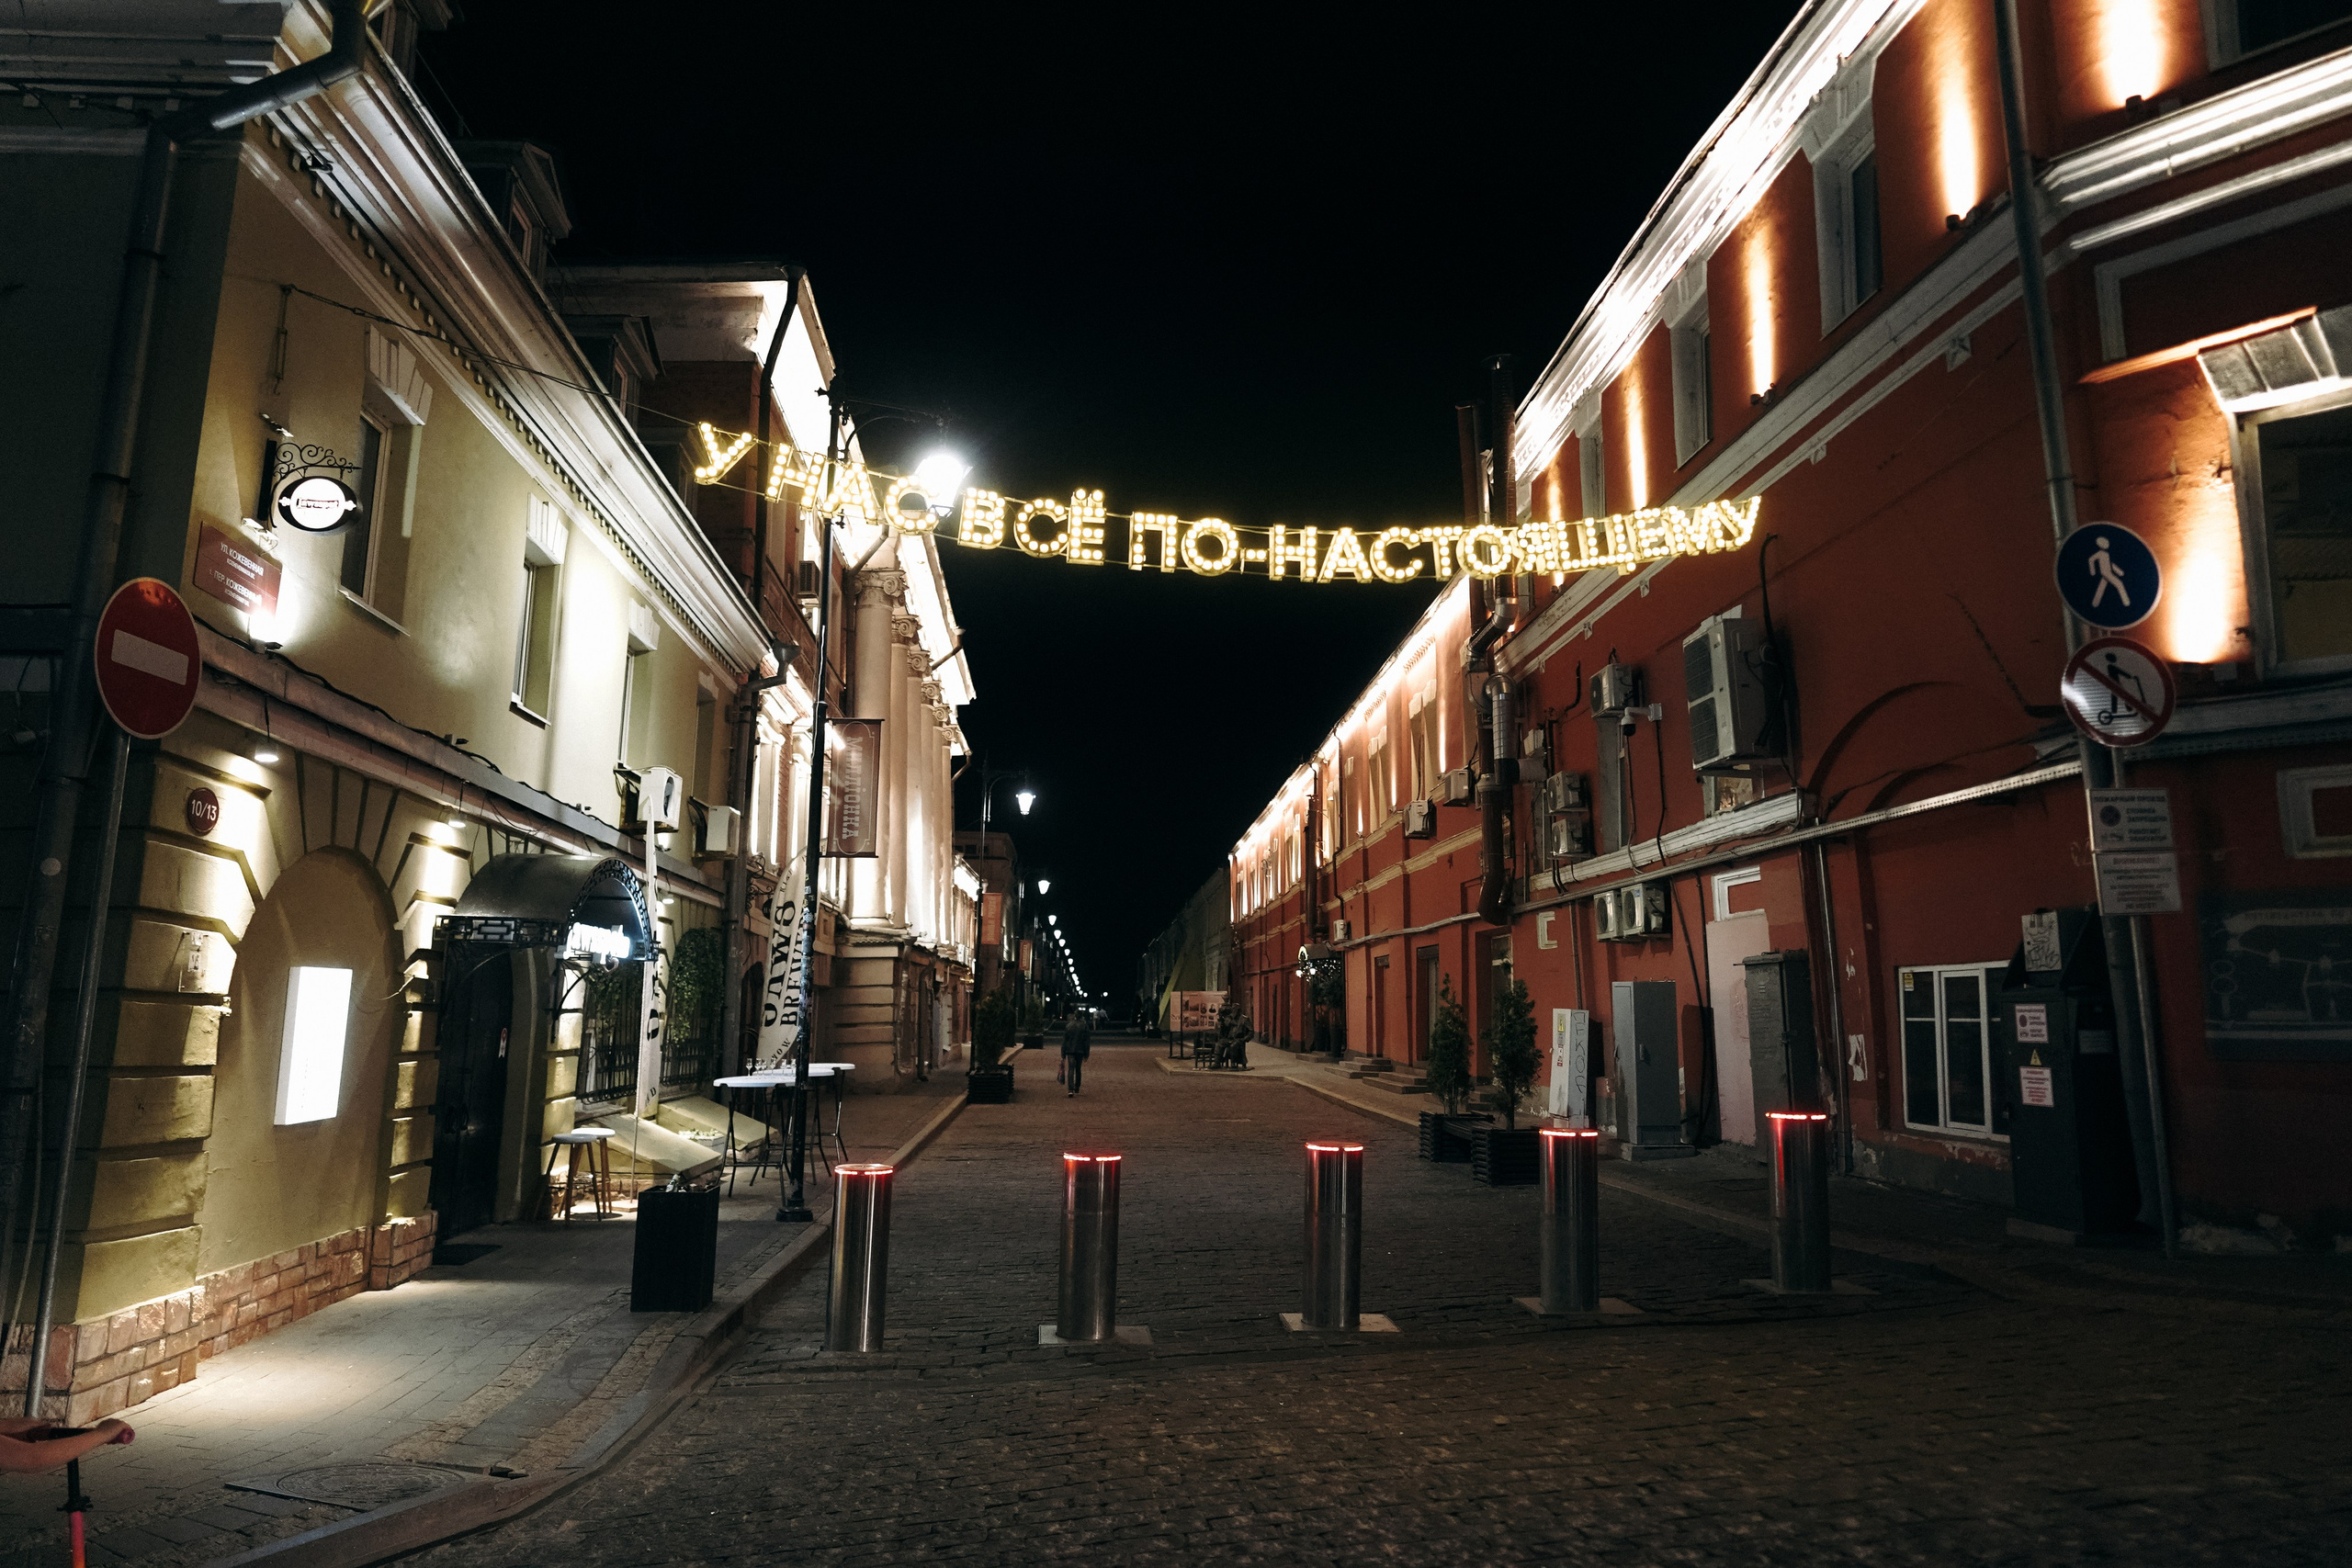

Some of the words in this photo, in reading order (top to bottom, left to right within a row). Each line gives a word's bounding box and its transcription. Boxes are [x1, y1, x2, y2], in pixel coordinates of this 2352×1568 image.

[695, 422, 756, 484] У
[764, 442, 939, 535] НАС
[957, 488, 1106, 566] ВСЁ
[1128, 495, 1761, 585] ПО-НАСТОЯЩЕМУ
[229, 548, 264, 577] КОЖЕВЕННАЯ
[192, 799, 217, 821] 10/13
[762, 900, 796, 1028] JAWS
